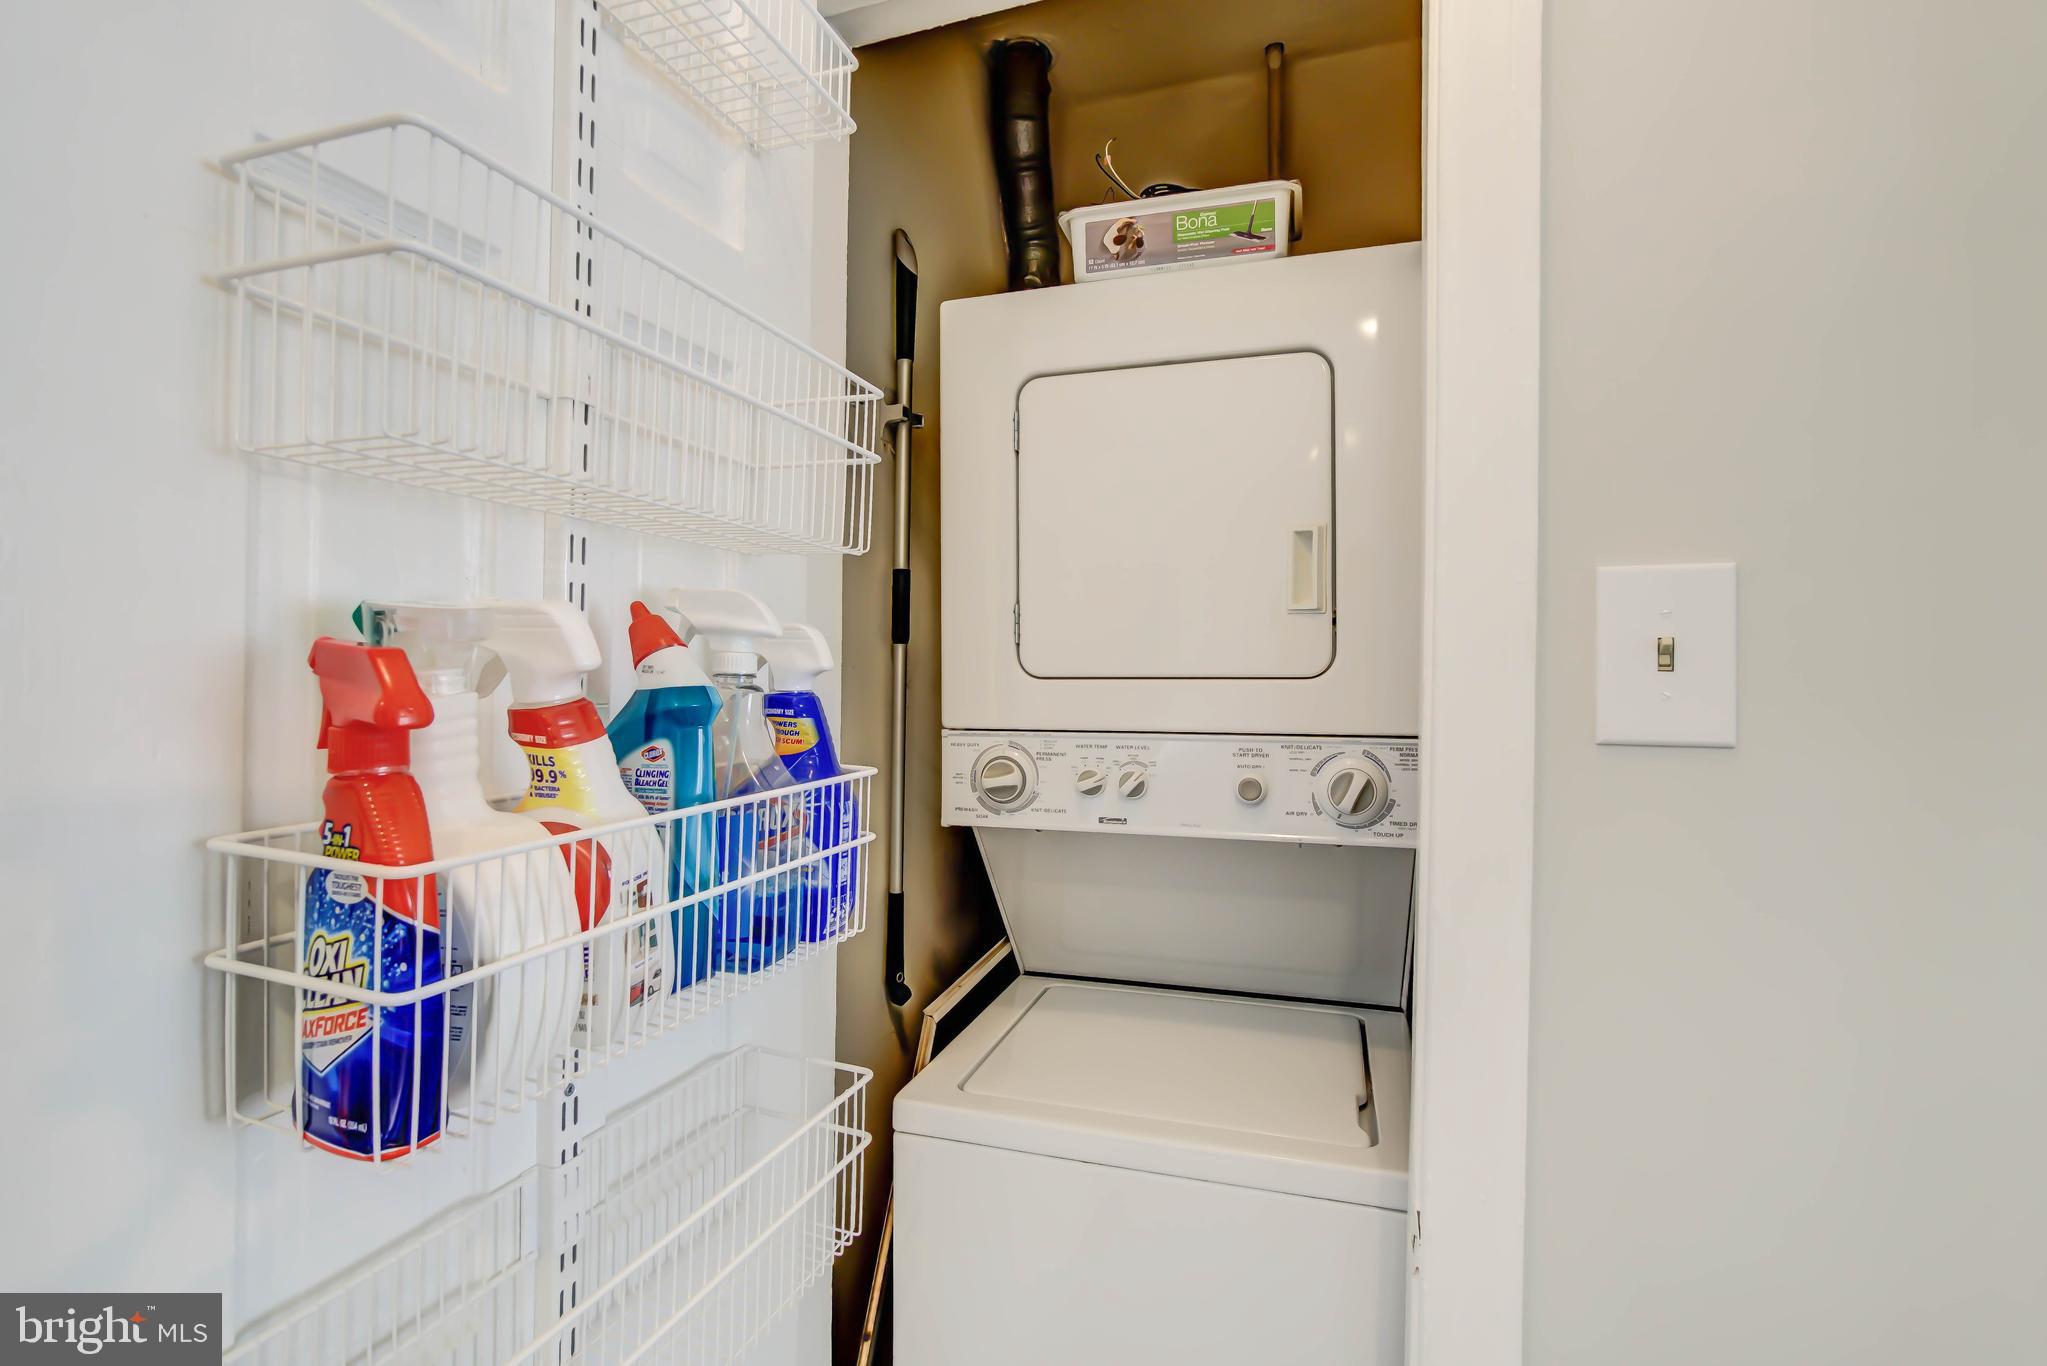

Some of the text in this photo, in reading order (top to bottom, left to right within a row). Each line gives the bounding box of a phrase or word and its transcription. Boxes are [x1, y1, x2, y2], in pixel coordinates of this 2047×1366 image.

[1176, 215, 1218, 231] Bona
[772, 720, 798, 729] OWERS
[635, 768, 670, 779] CLINGING
[634, 778, 669, 788] BLEACH GEL
[324, 845, 360, 861] POWER
[331, 880, 362, 891] TOUGHEST
[308, 935, 350, 977] OXI
[303, 965, 365, 1010] LEAN
[302, 1006, 369, 1040] AXFORCE
